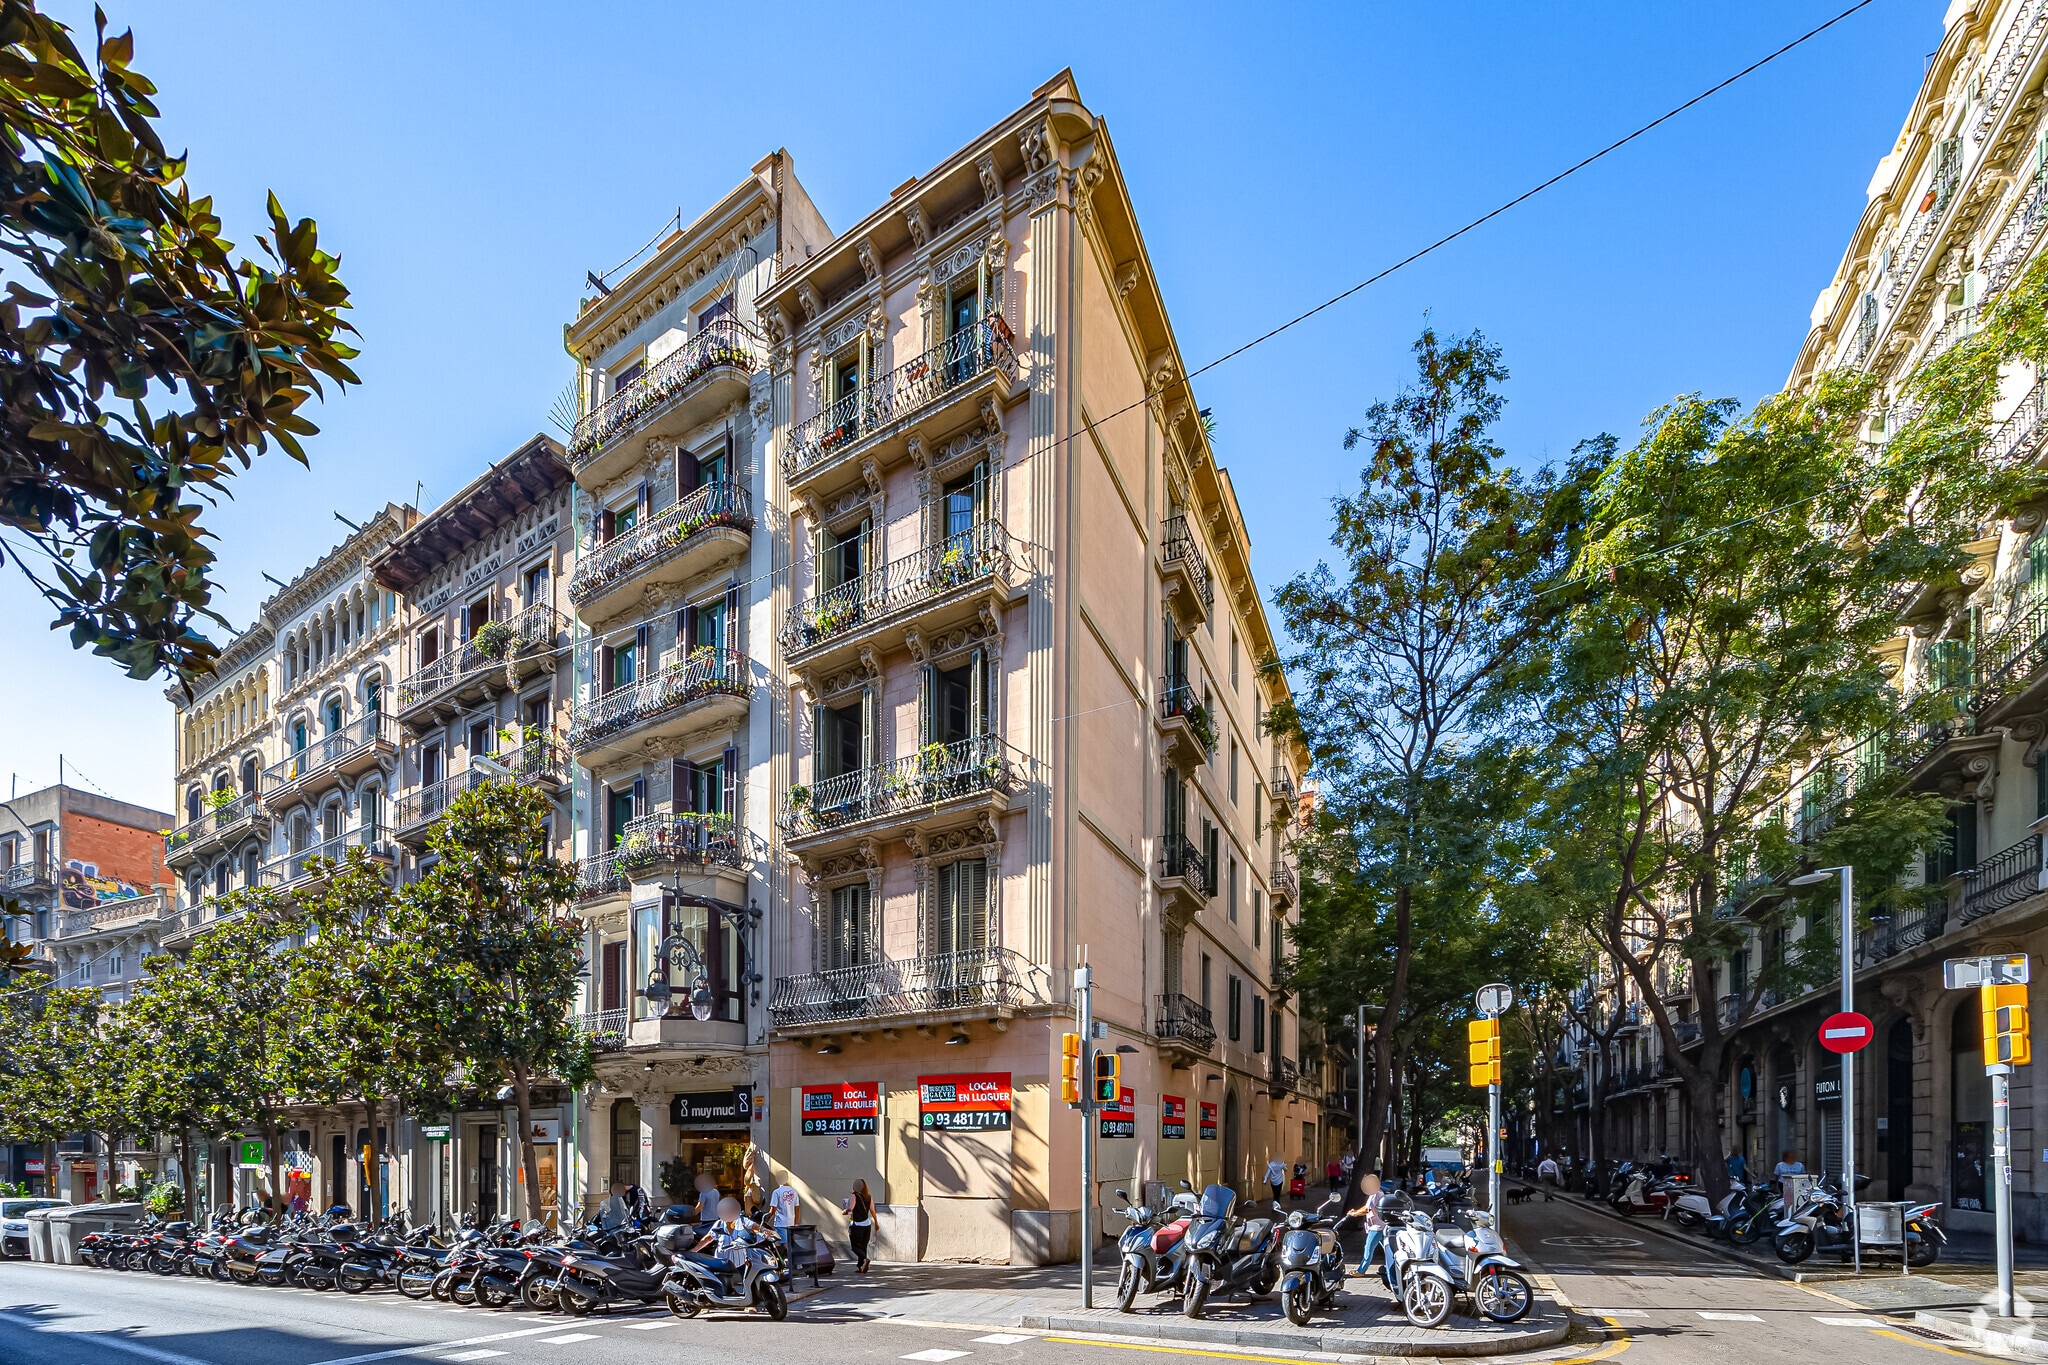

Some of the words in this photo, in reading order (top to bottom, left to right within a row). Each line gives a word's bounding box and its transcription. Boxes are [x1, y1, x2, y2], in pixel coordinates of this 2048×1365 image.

[969, 1082, 998, 1091] LOCAL
[1816, 1081, 1835, 1093] FUTON
[843, 1090, 867, 1099] LOCAL
[958, 1093, 970, 1102] EN
[971, 1092, 1010, 1102] LLOGUER
[834, 1101, 843, 1110] EN
[844, 1100, 877, 1110] ALQUILER
[691, 1107, 712, 1119] muy
[712, 1104, 736, 1116] muc
[815, 1120, 827, 1131] 93
[829, 1119, 846, 1131] 481
[848, 1119, 859, 1130] 71
[861, 1118, 873, 1130] 71
[936, 1113, 950, 1126] 93
[952, 1112, 974, 1125] 481
[976, 1112, 990, 1125] 71
[992, 1112, 1007, 1125] 71
[1109, 1121, 1116, 1133] 93
